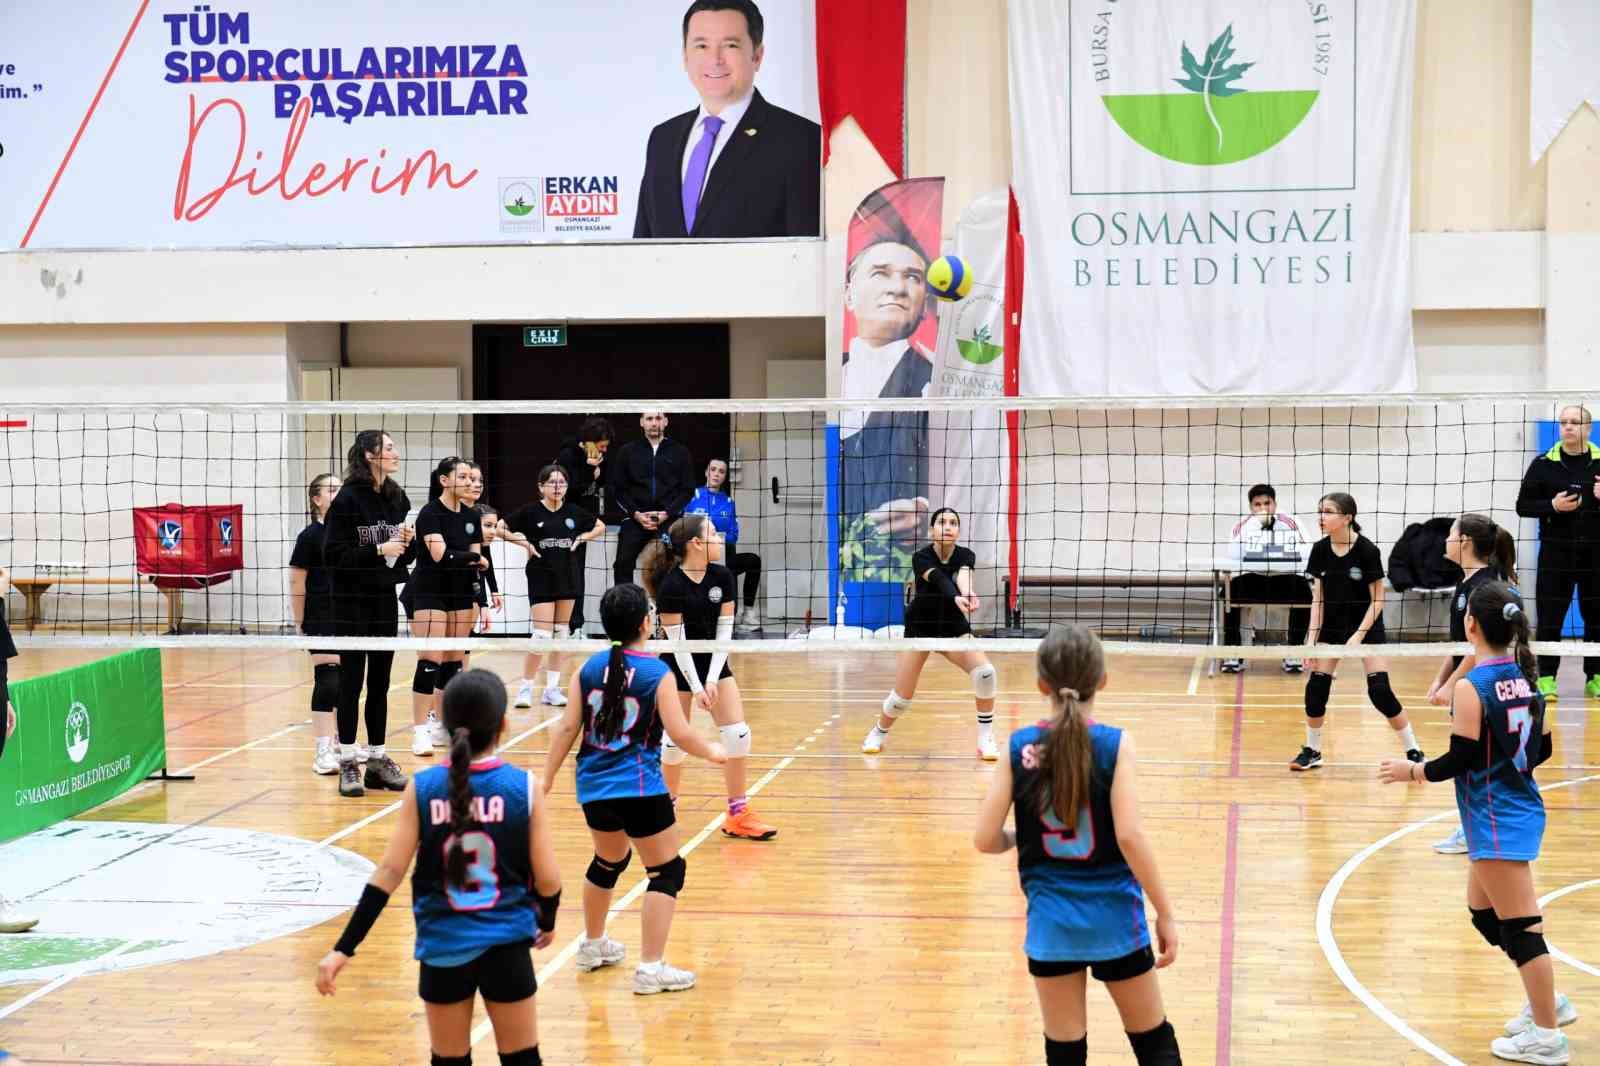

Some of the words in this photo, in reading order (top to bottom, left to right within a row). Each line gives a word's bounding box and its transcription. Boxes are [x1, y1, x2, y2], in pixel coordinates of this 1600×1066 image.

[164, 5, 250, 46] TÜM
[1091, 11, 1112, 82] BURSA
[164, 44, 528, 84] SPORCULARIMIZA
[1313, 33, 1331, 76] 1987
[274, 80, 528, 124] BAŞARILAR
[174, 94, 478, 222] Dilerim
[545, 175, 618, 194] ERKAN
[548, 194, 615, 214] AYDIN
[1071, 203, 1353, 246] OSMANGAZİ
[1074, 251, 1353, 287] BELEDİYESİ
[530, 329, 560, 337] EXIT
[1506, 705, 1534, 772] 7
[16, 779, 70, 806] OSMANGAZİ
[71, 754, 131, 793] BELEDİYESPOR
[444, 830, 501, 912] 3
